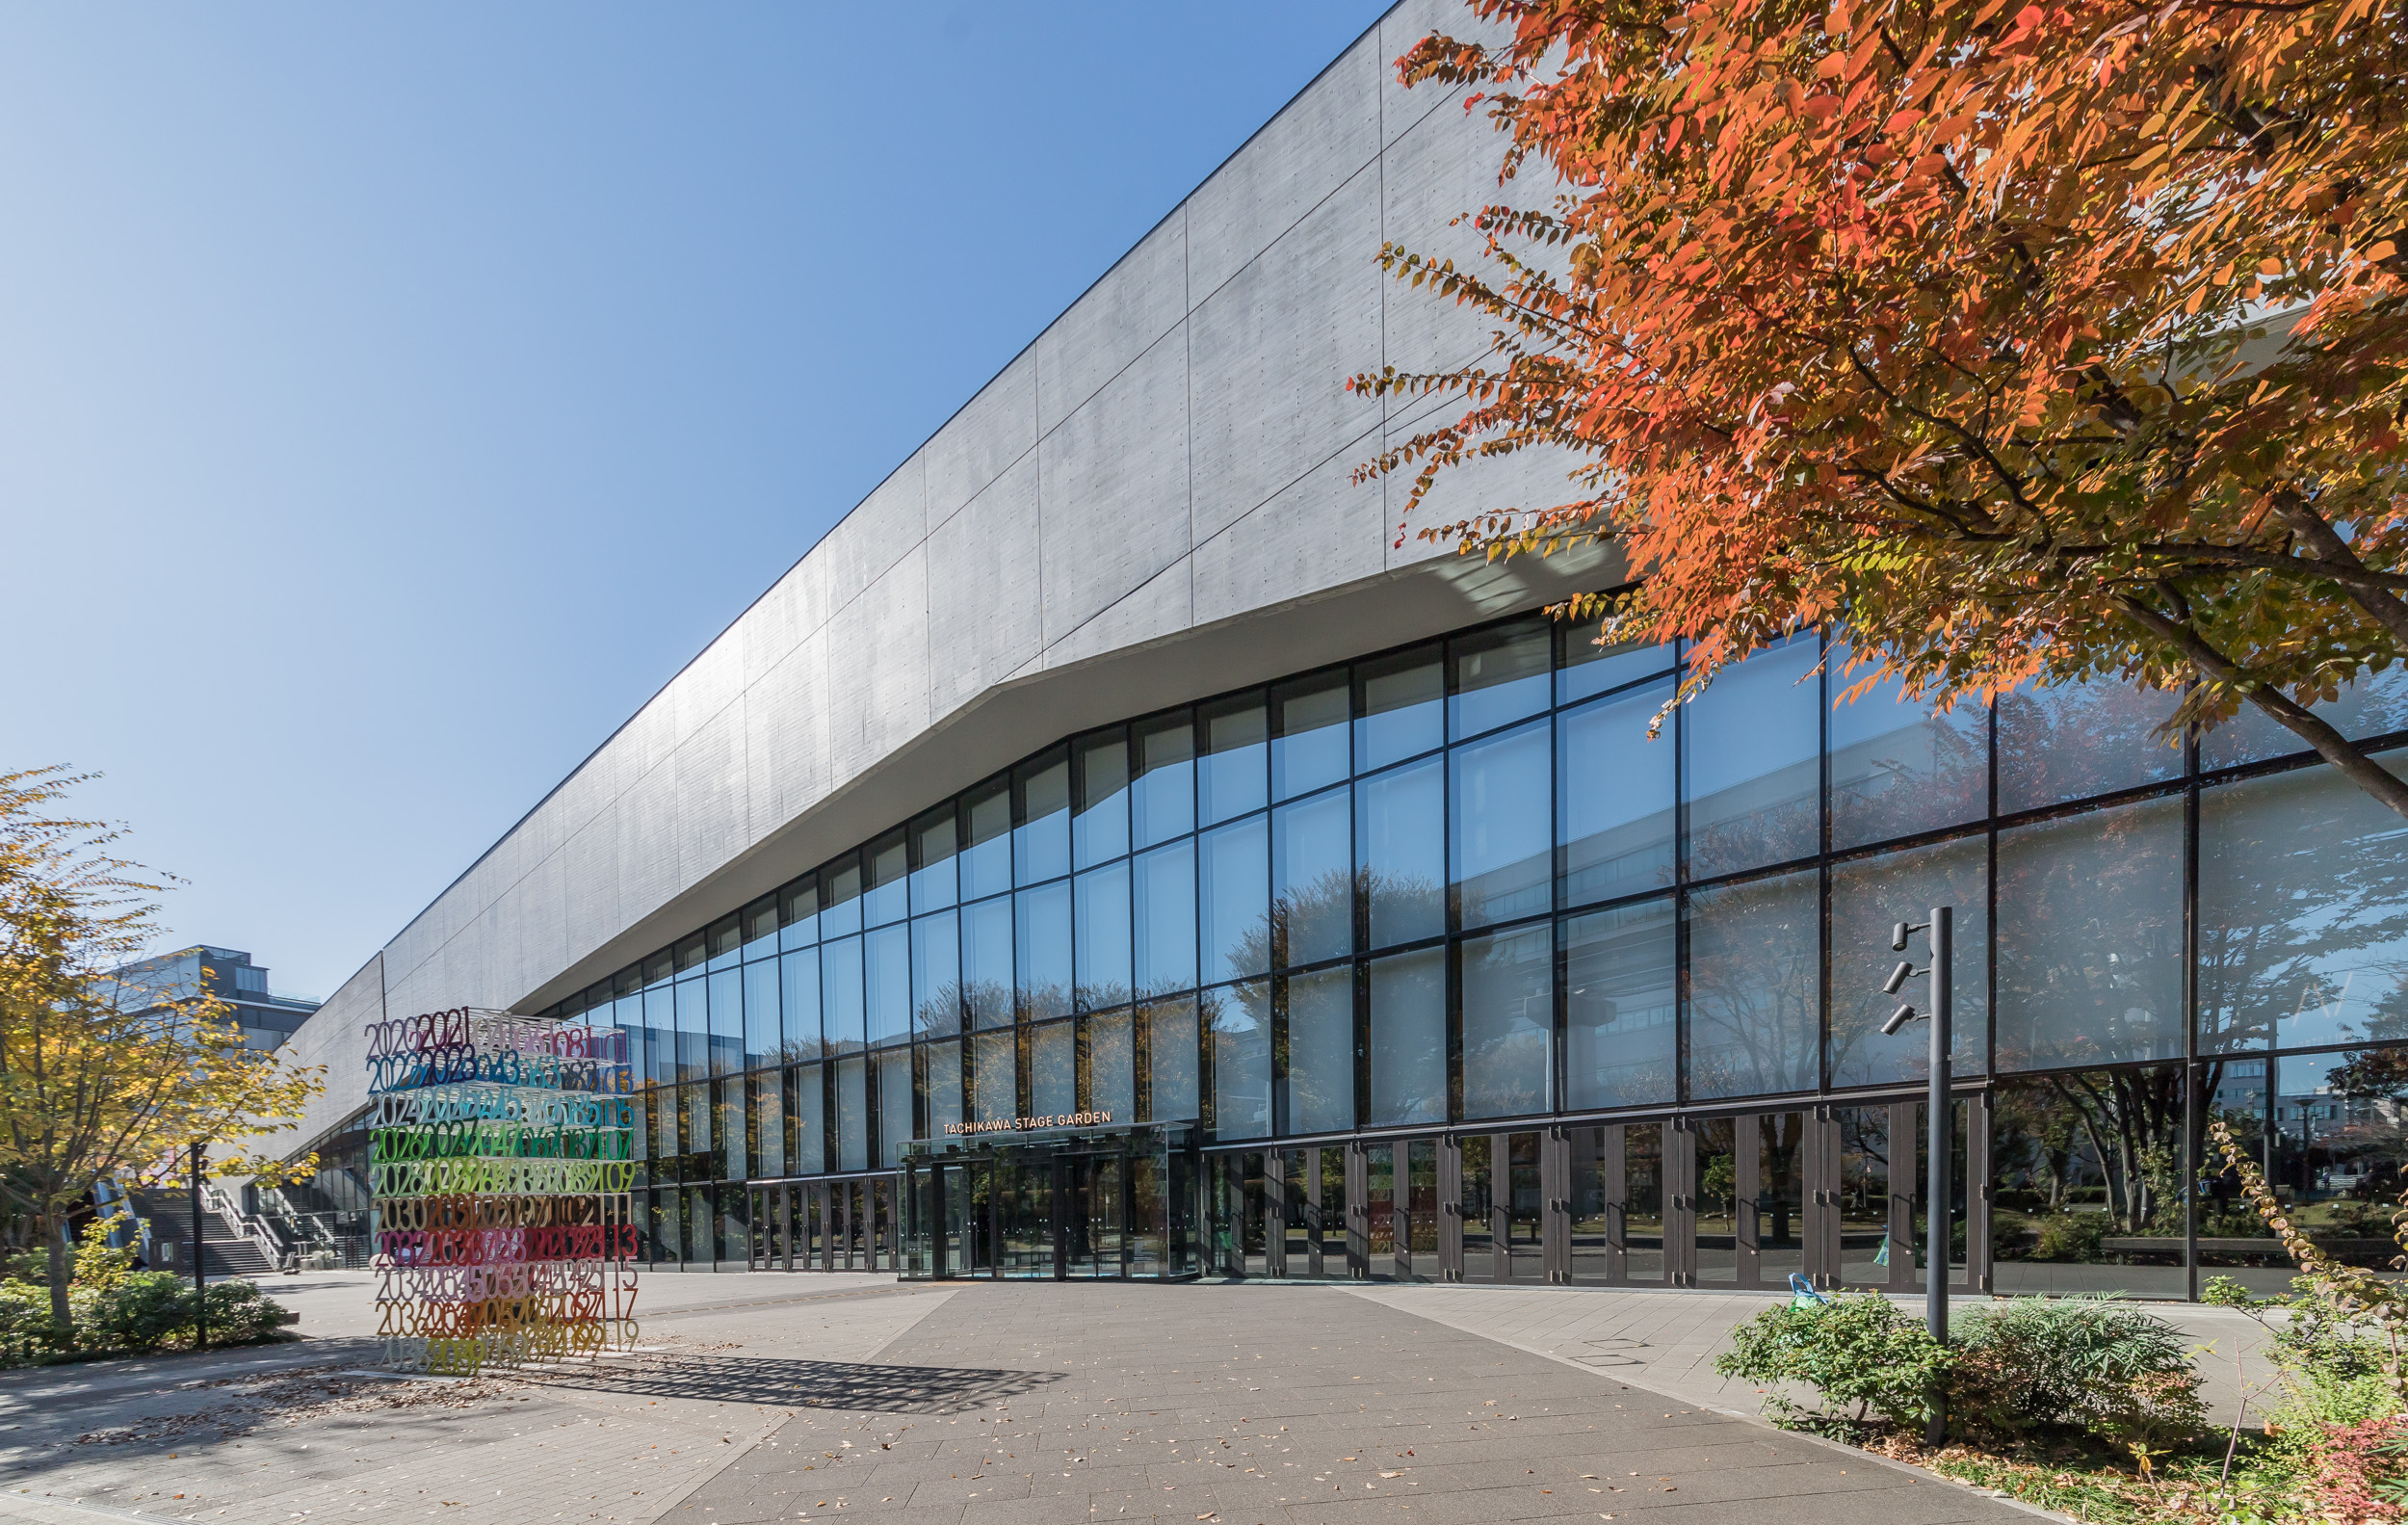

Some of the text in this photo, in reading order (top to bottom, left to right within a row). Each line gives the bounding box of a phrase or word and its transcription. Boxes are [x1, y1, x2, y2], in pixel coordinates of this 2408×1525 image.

[365, 1016, 419, 1060] 2020
[418, 1006, 469, 1050] 2021
[367, 1052, 421, 1094] 2022
[419, 1043, 477, 1087] 2023
[369, 1089, 422, 1129] 2024
[943, 1111, 1112, 1135] TACHIKAWA STAGE GARDEN
[370, 1123, 423, 1163] 2026
[423, 1115, 479, 1160] 2027
[372, 1160, 425, 1198] 2028
[424, 1155, 479, 1196] 2029
[373, 1196, 427, 1232] 2030
[425, 1193, 476, 1233] 2031
[376, 1301, 429, 1337] 2036
[428, 1339, 484, 1376] 2039
